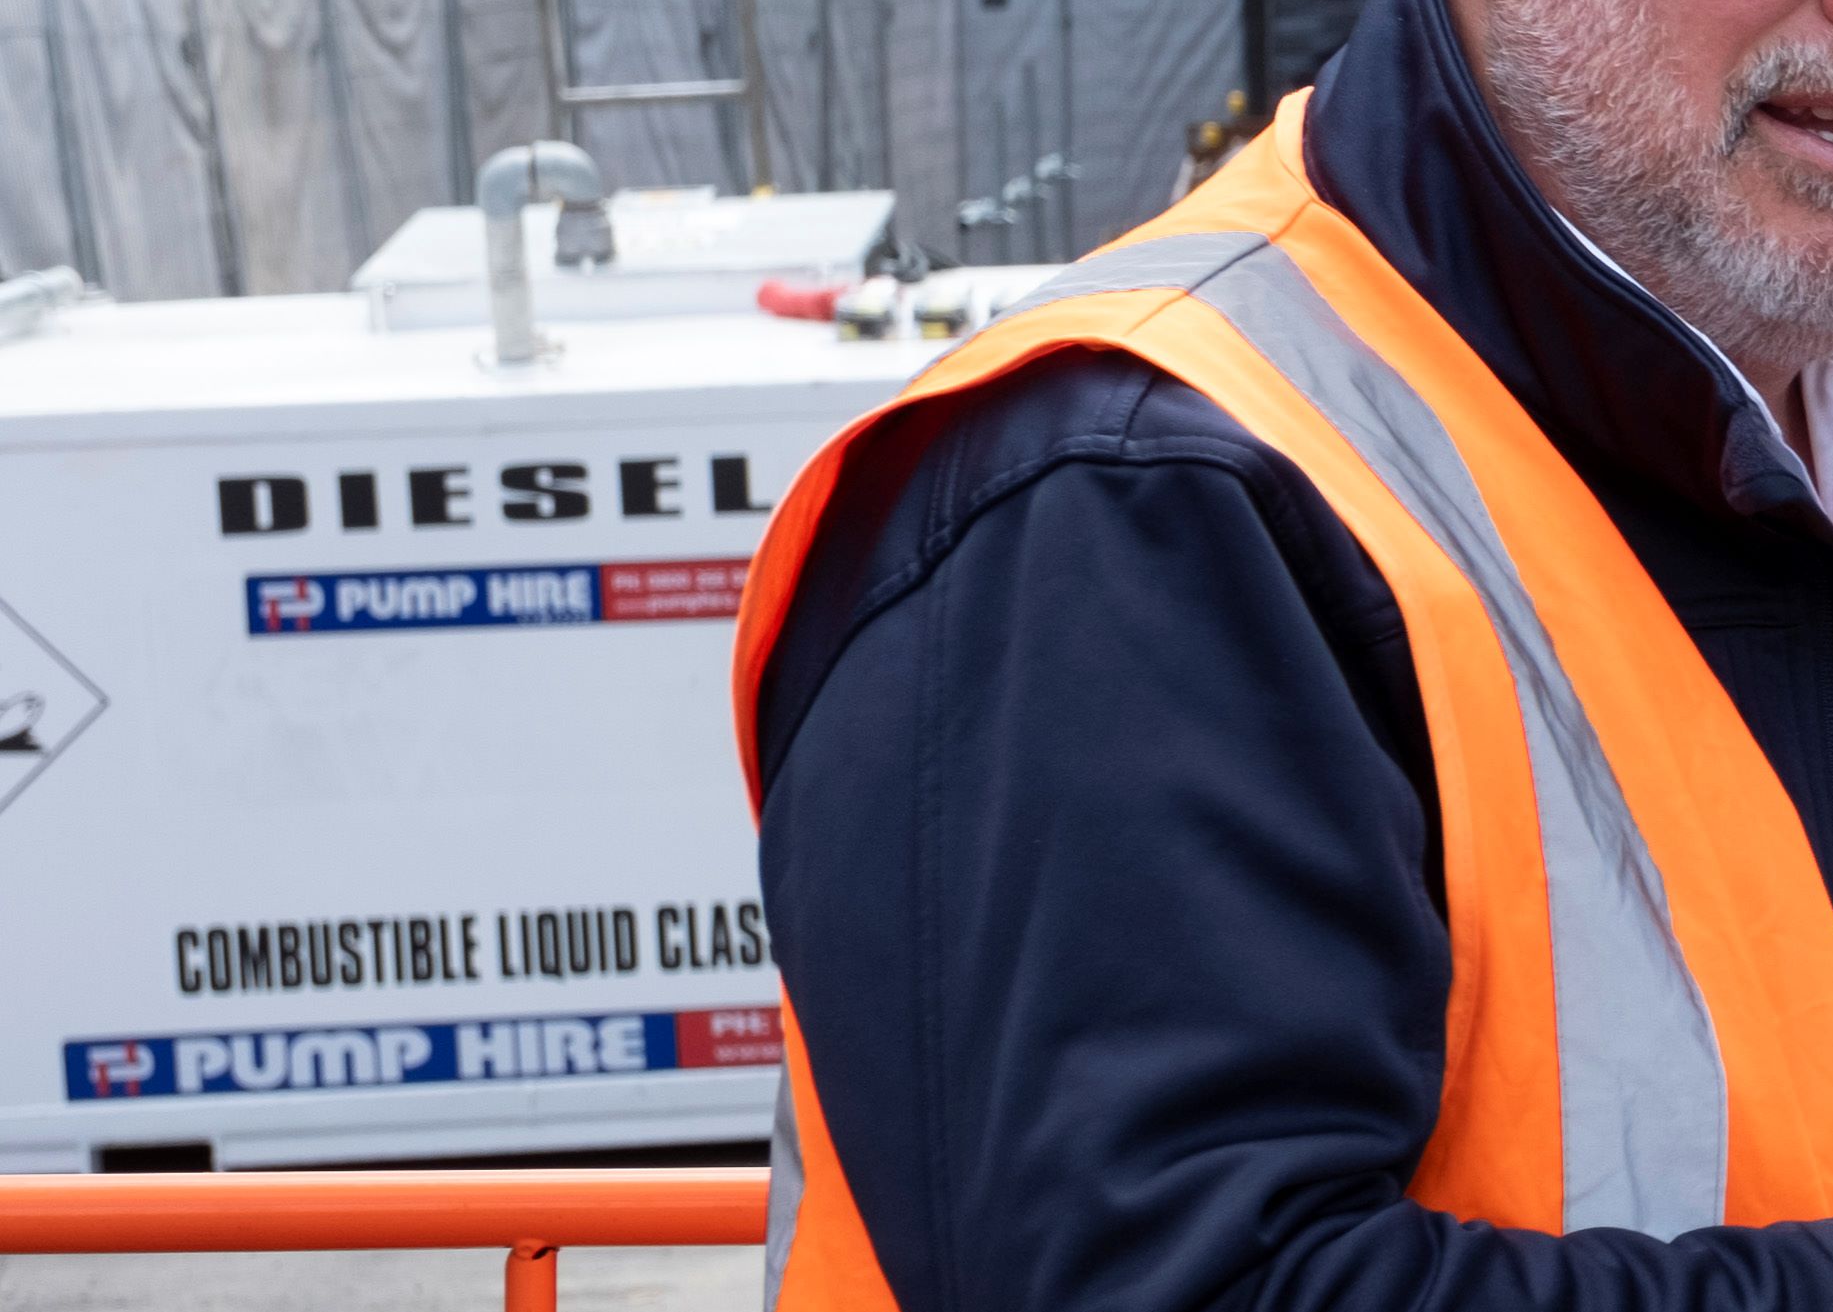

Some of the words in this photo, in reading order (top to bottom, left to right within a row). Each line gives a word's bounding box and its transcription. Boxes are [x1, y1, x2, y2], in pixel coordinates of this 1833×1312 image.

[218, 455, 773, 537] DIESEL
[336, 575, 478, 623] PUMP
[487, 569, 593, 618] HIRE
[177, 915, 479, 994] COMBUSTIBLE
[497, 908, 638, 978] LIQUID
[656, 902, 767, 970] CLAS
[175, 1027, 433, 1094] PUMP
[456, 1016, 646, 1080] HIRE
